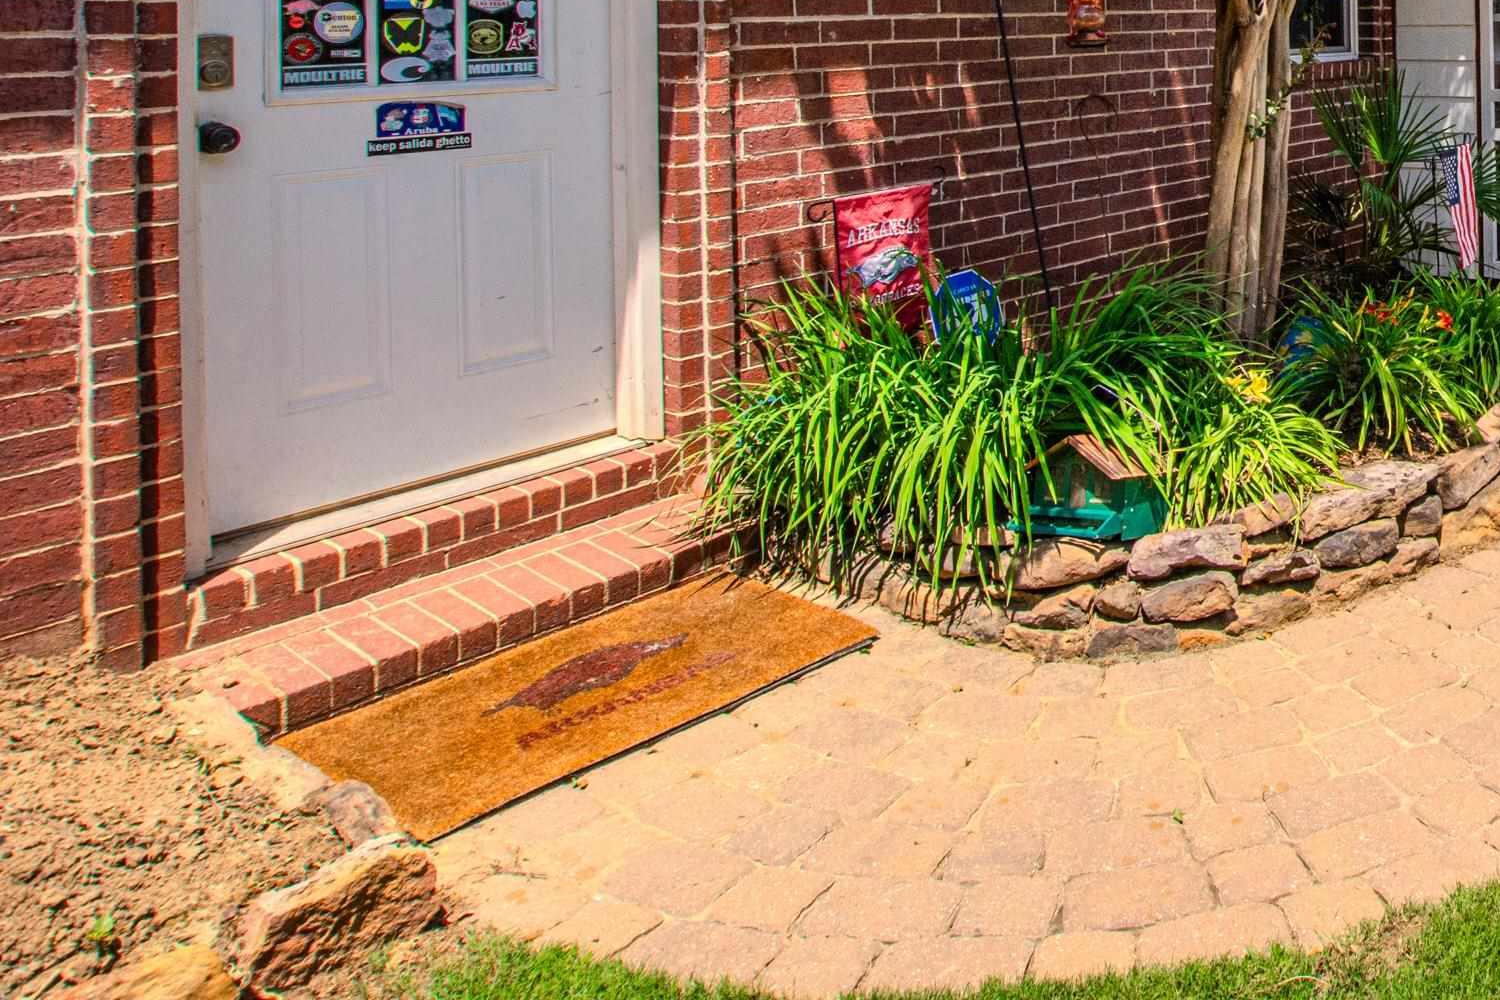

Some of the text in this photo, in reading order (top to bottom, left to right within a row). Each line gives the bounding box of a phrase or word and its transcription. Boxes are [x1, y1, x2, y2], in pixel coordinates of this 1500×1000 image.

[468, 61, 536, 75] MOULTRIE
[284, 70, 365, 83] MOULTRIE
[405, 127, 438, 135] Aruba
[368, 135, 471, 152] keep salida ghetto
[847, 217, 920, 248] ARKANSAS
